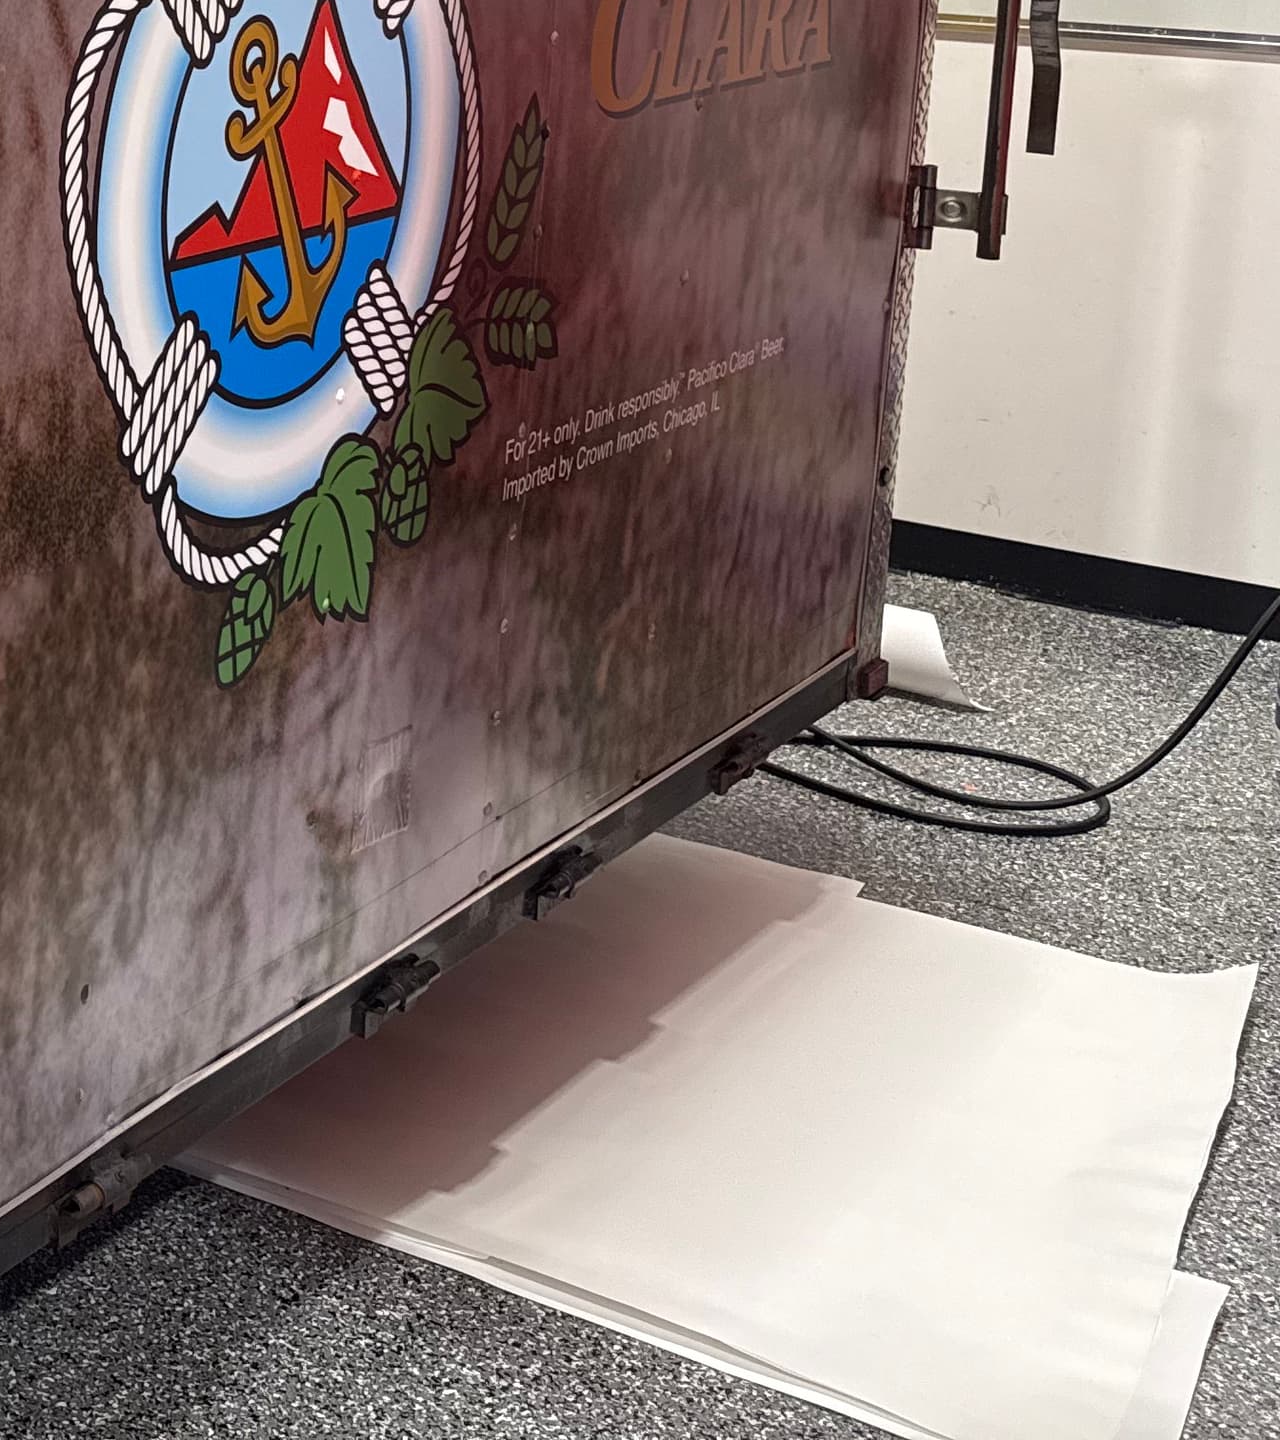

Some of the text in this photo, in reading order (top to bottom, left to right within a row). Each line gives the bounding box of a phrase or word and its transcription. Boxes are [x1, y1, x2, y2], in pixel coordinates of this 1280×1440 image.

[502, 390, 721, 502] Imported by Crown Imports, Chicago, IL
[505, 439, 527, 464] For
[528, 430, 550, 453] 21+
[553, 419, 581, 447] only.
[584, 403, 615, 433] Drink
[687, 361, 727, 392] Pacifico
[760, 335, 785, 361] Beer.
